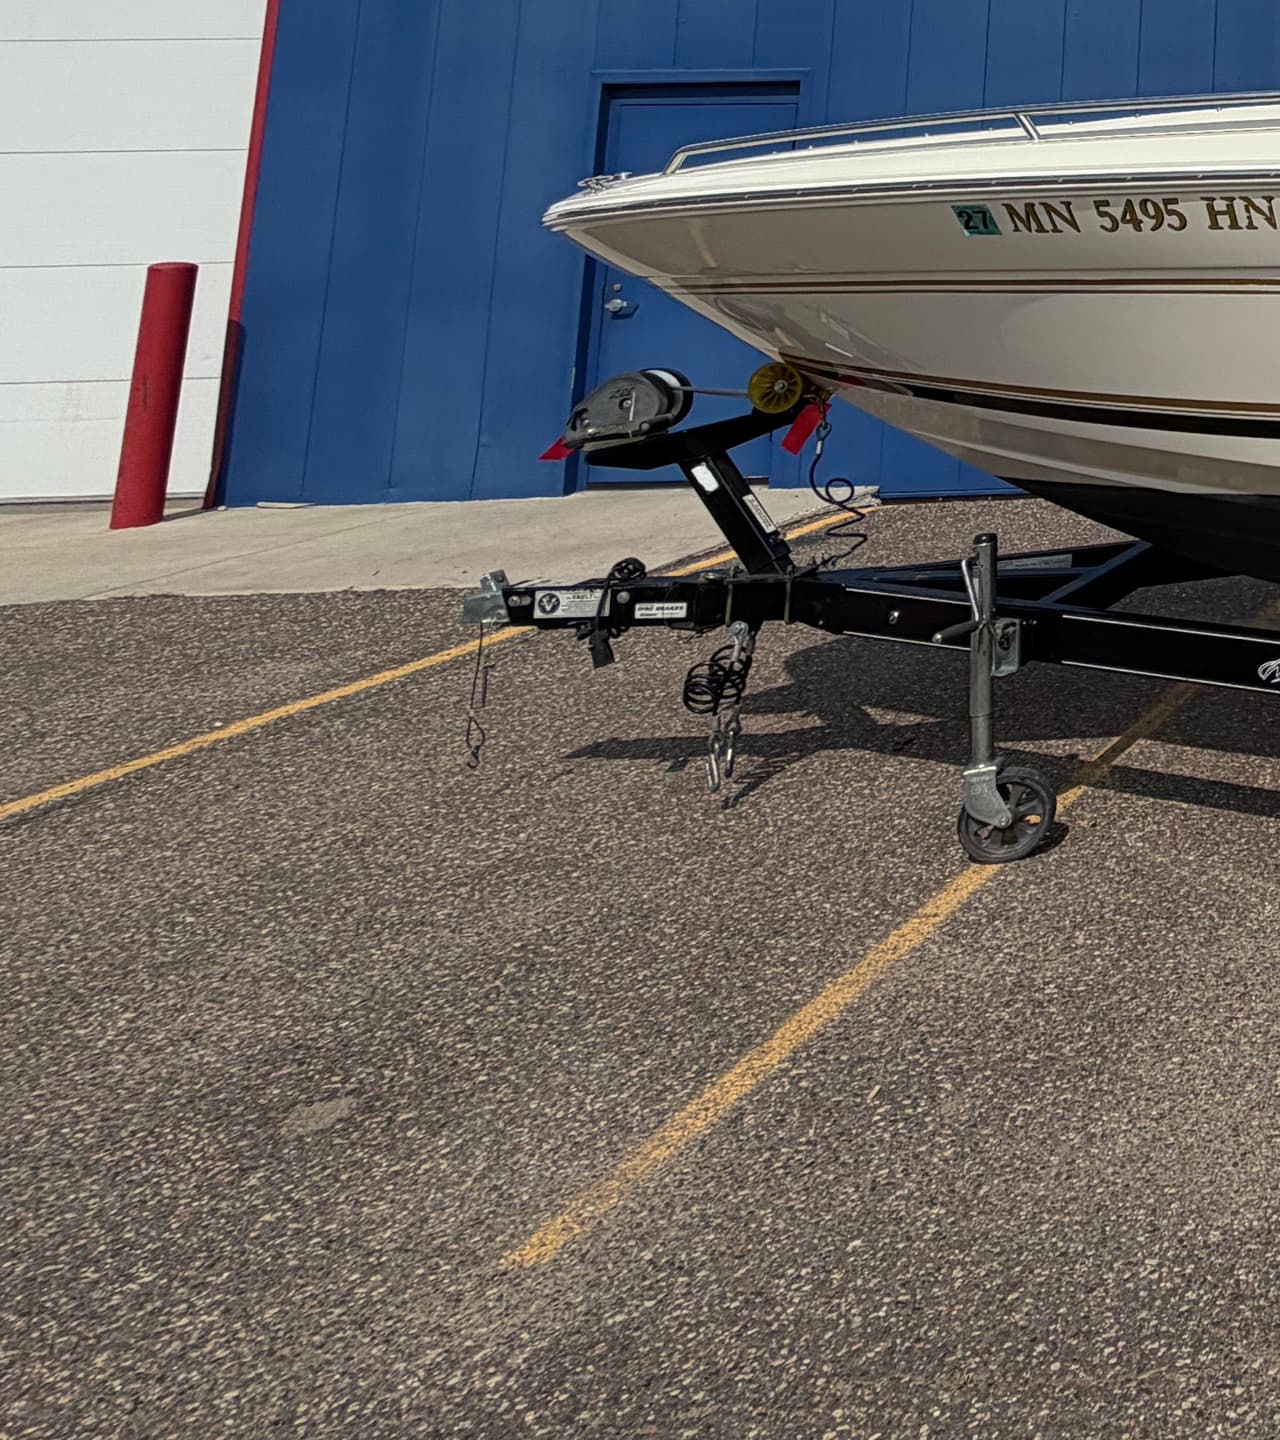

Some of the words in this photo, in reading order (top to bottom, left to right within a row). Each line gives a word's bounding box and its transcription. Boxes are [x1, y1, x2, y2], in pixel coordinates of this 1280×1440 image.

[957, 210, 990, 231] 27
[1001, 200, 1082, 234] MN
[1092, 197, 1188, 233] 5495
[1200, 195, 1277, 231] HN
